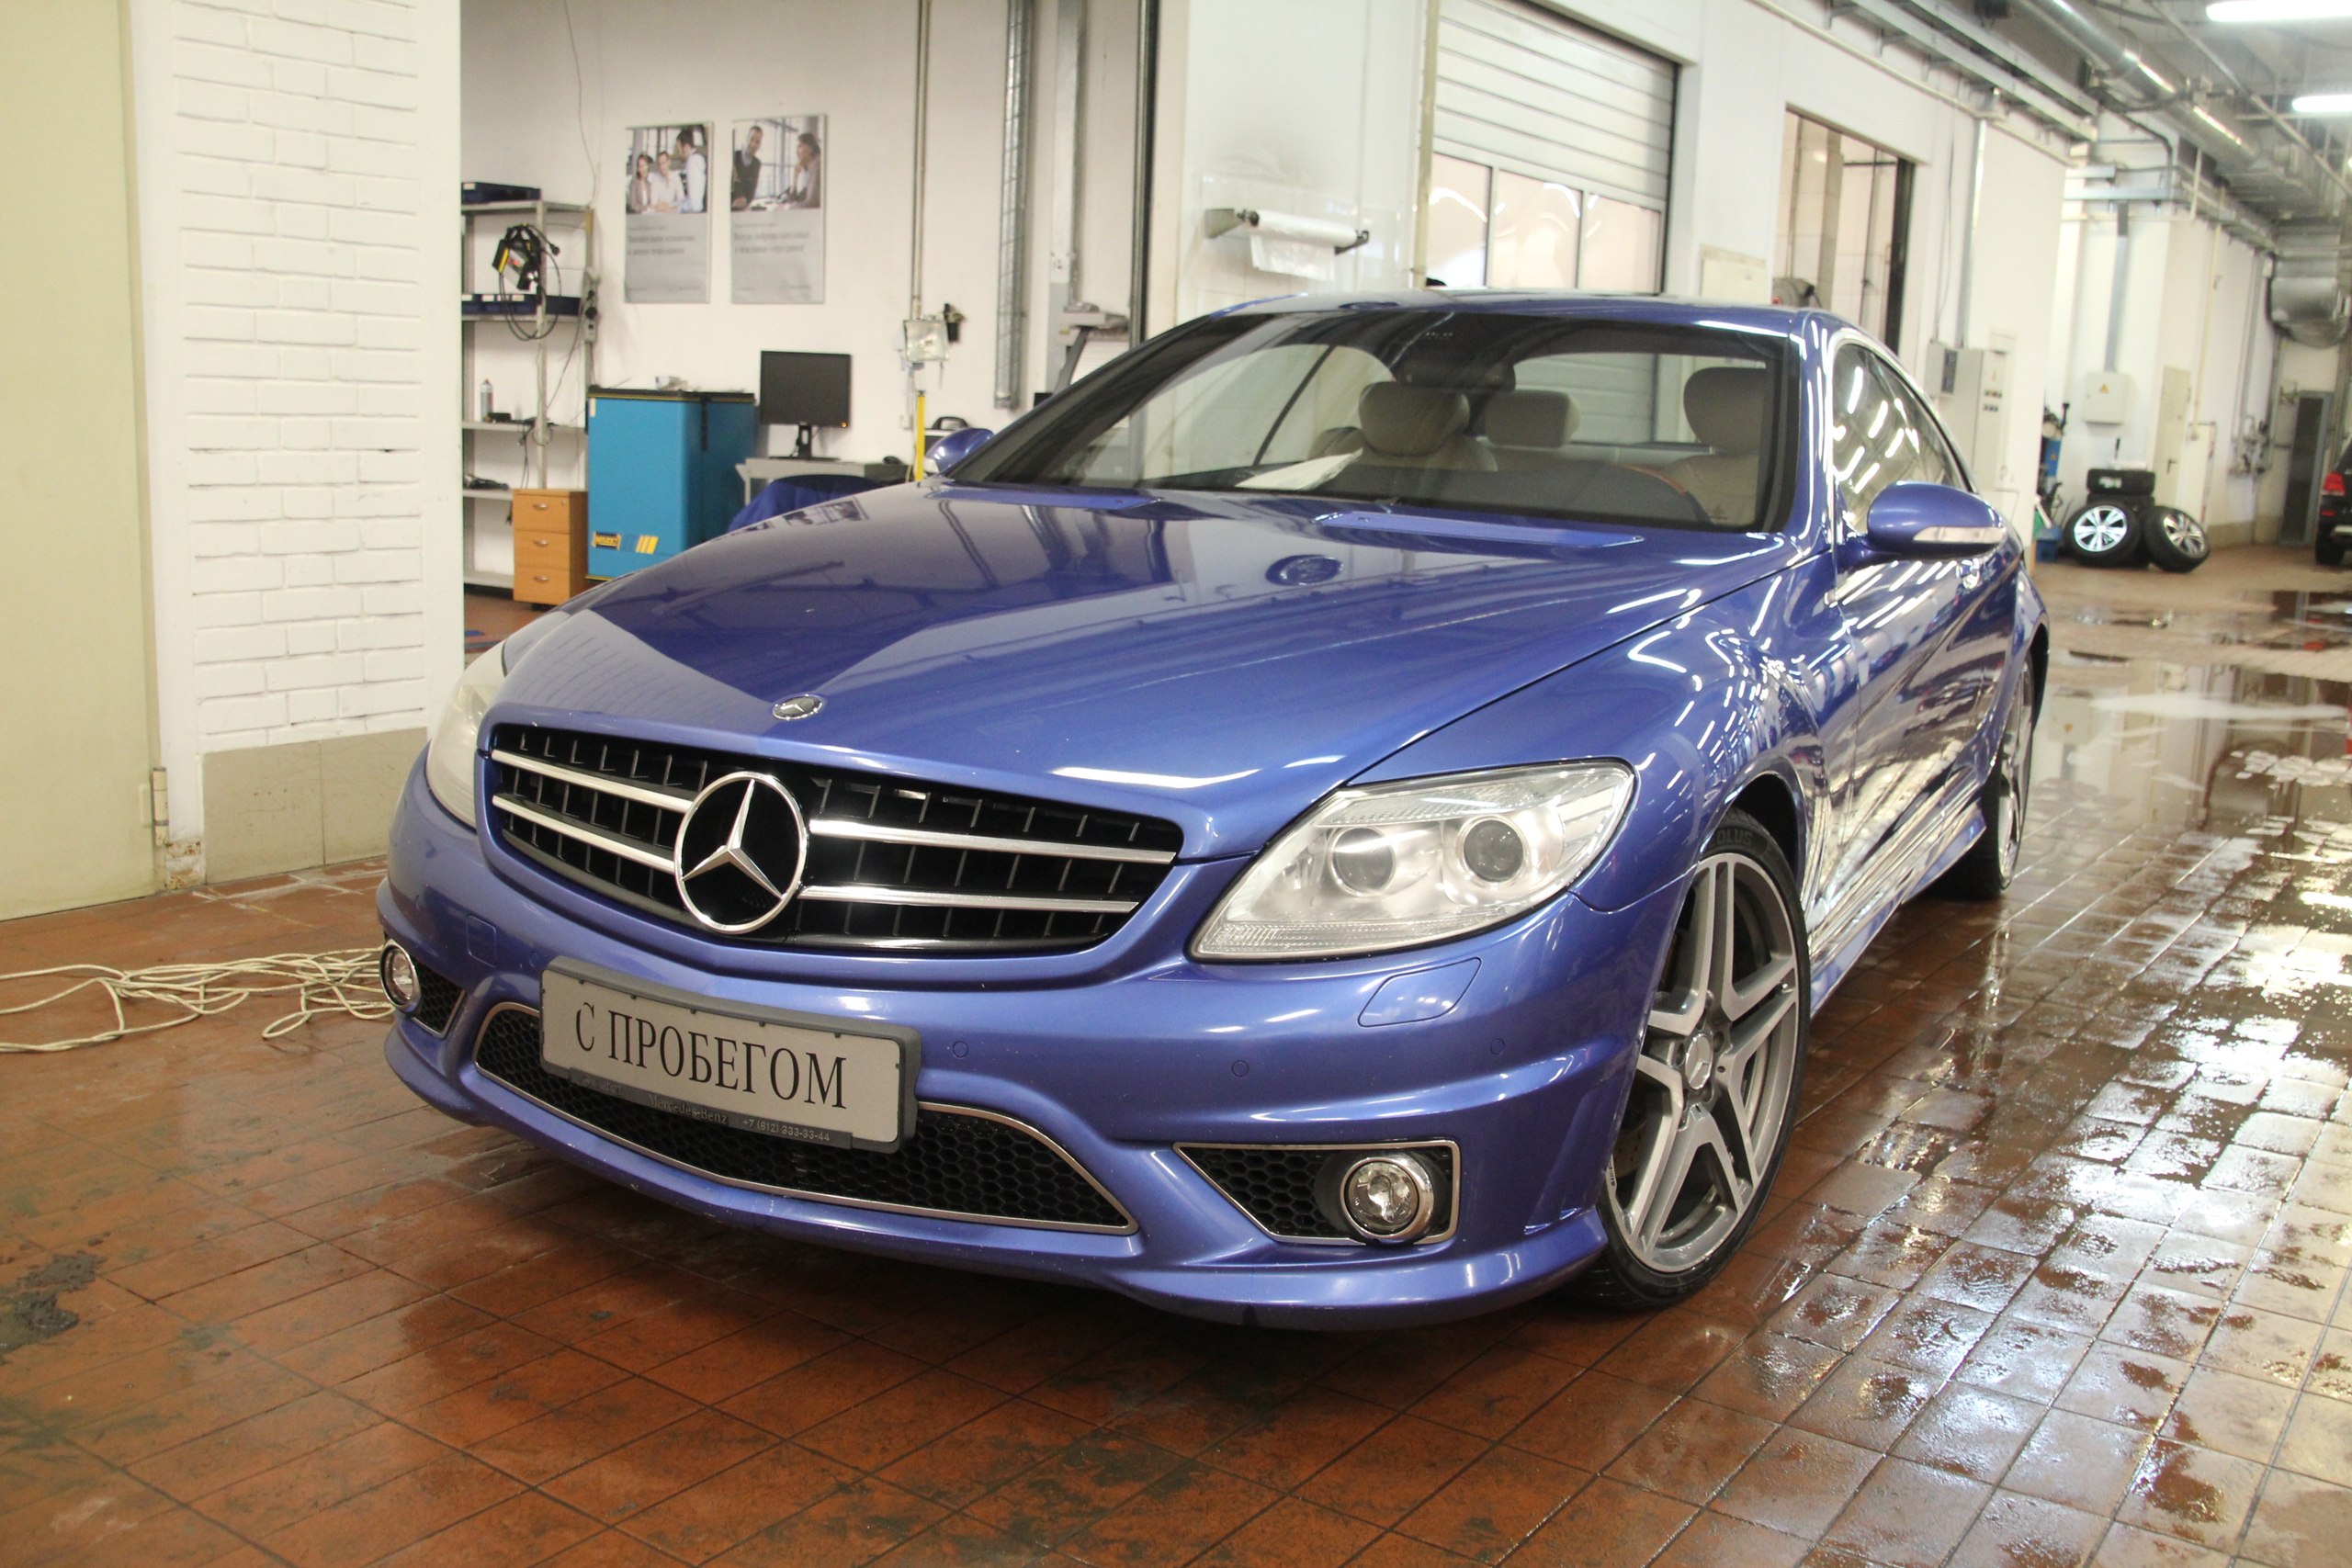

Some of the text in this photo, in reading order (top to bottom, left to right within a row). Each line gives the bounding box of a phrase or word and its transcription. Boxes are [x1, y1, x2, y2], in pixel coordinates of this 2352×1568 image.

[576, 1002, 847, 1110] С ПРОБЕГОМ
[648, 1093, 729, 1125] Mercedes-Benz
[742, 1119, 831, 1142] +7 (812) 333-33-44
